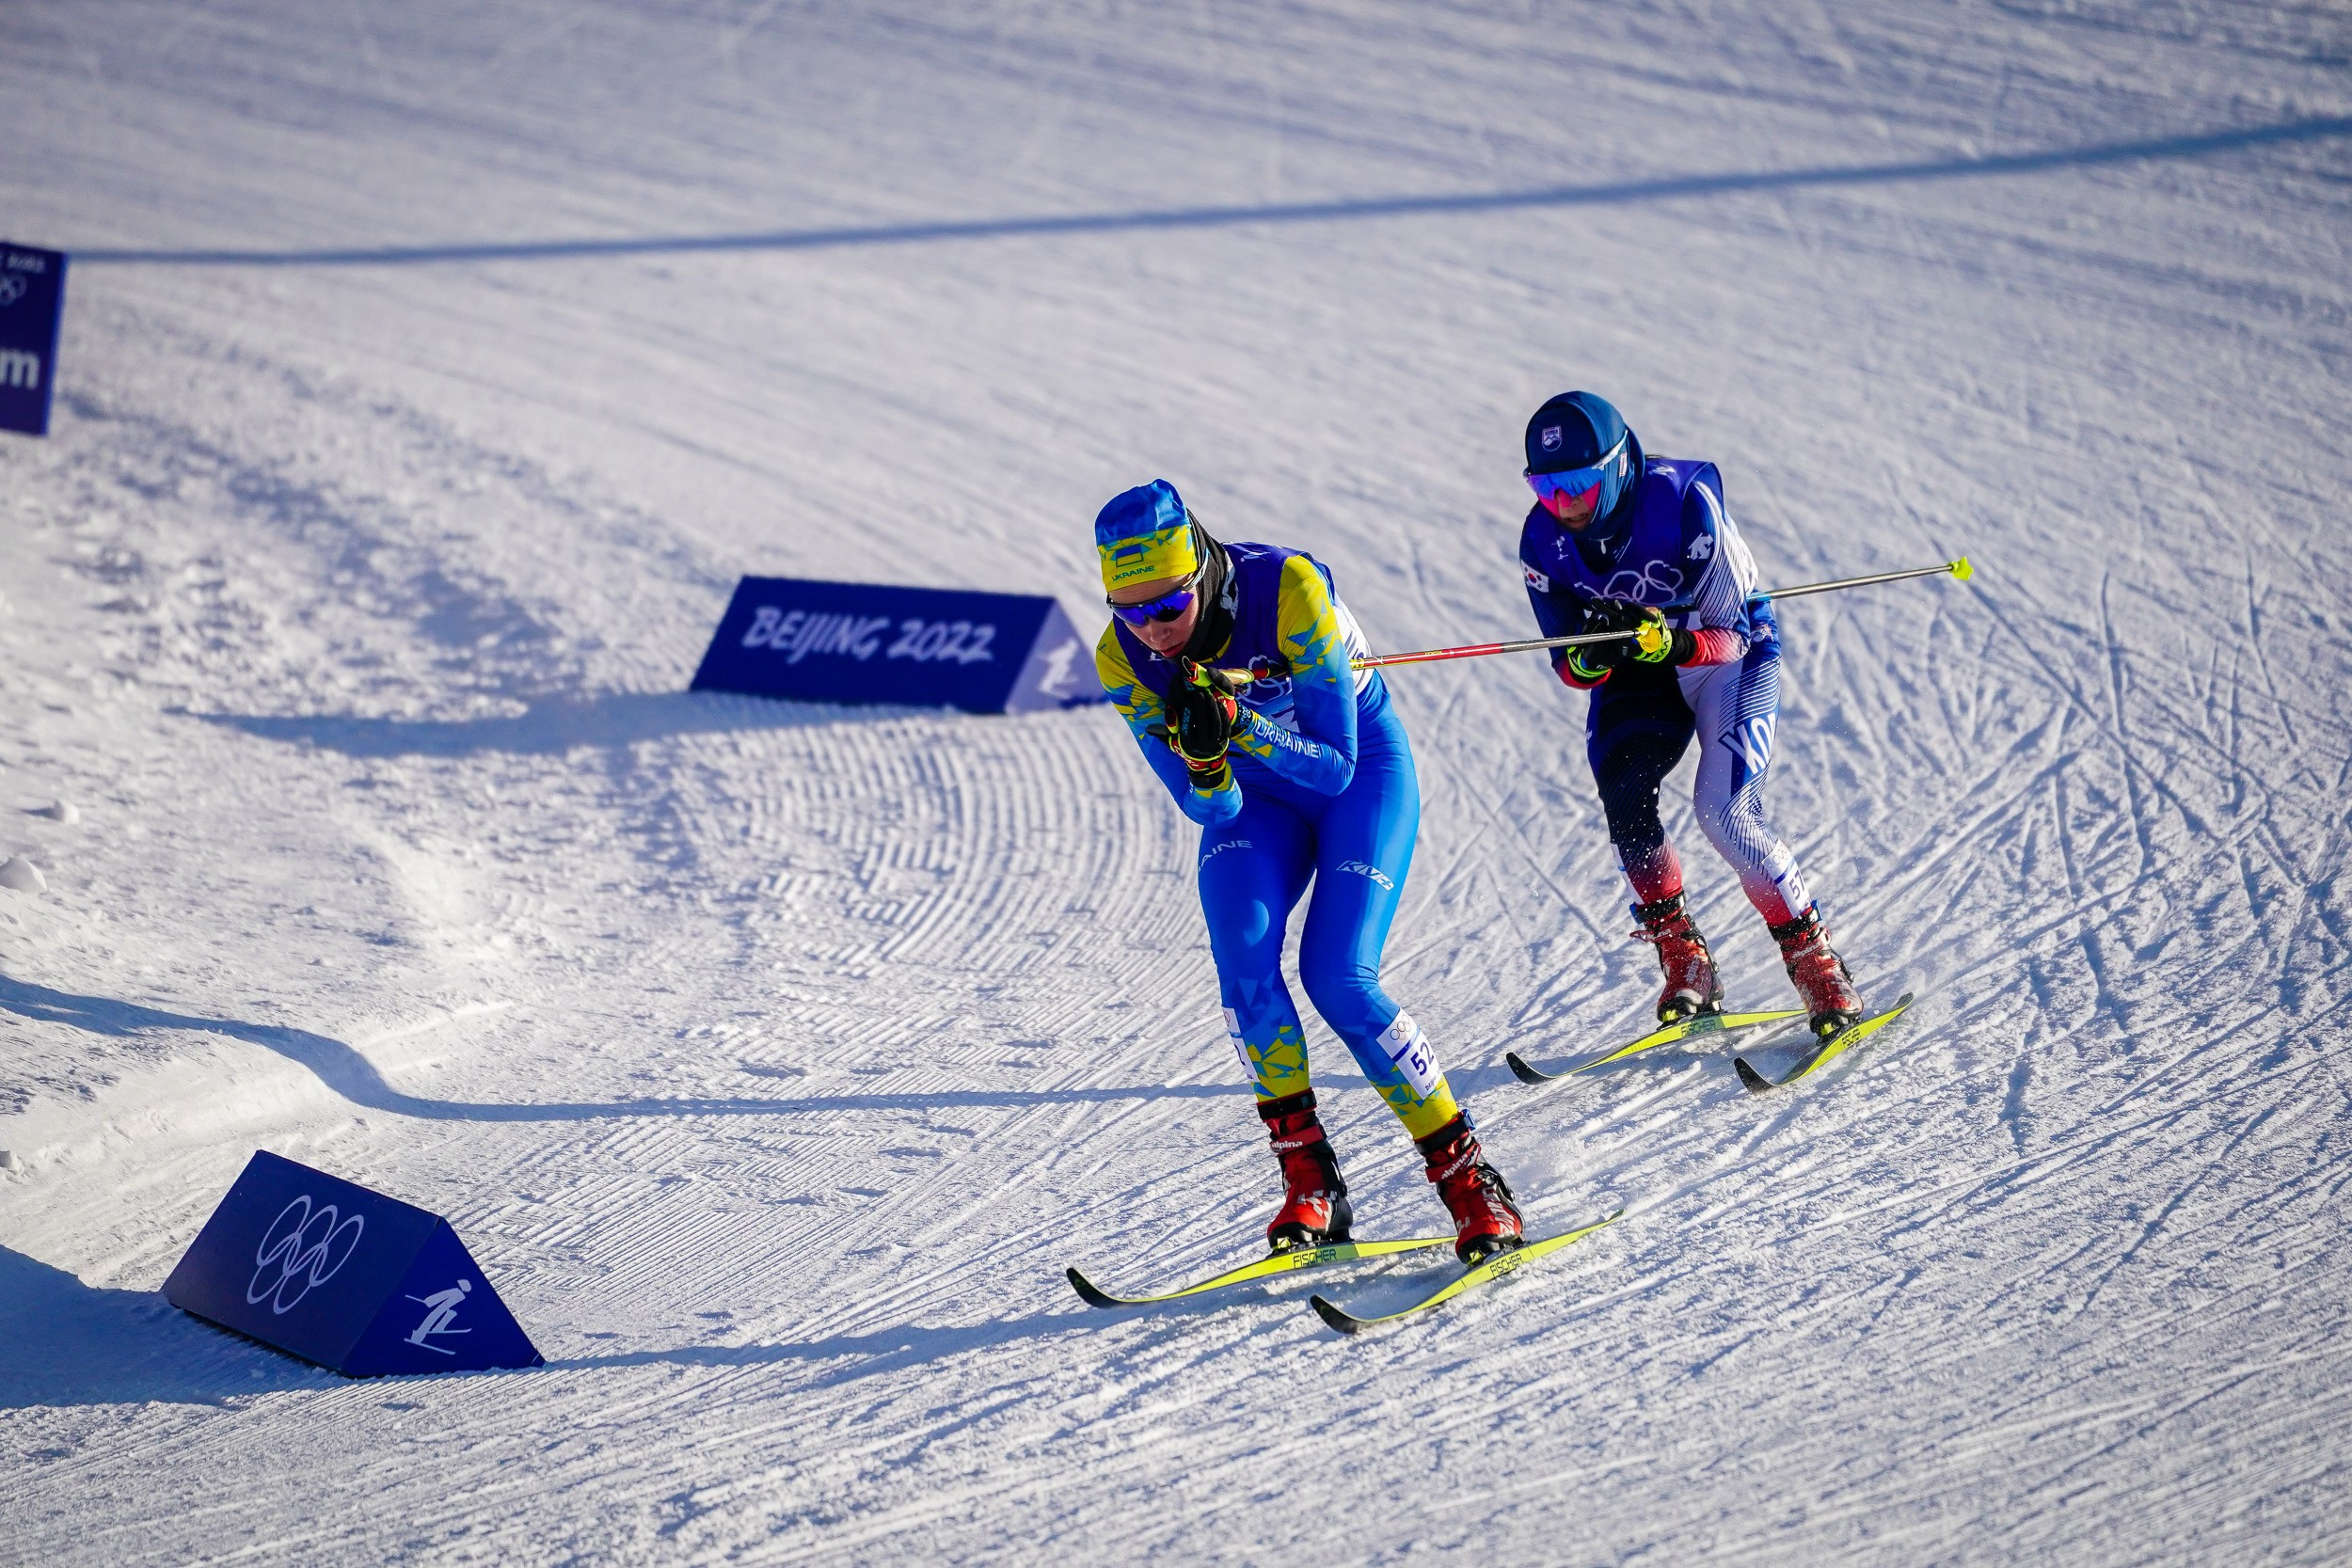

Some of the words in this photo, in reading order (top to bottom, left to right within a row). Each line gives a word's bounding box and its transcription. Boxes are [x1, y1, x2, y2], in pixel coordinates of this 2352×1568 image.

[1111, 564, 1155, 581] UKRAINE
[741, 605, 891, 665] BEIJING
[886, 618, 996, 665] 2022
[1255, 720, 1320, 759] UKRAINE
[1788, 869, 1805, 900] 57
[1410, 1041, 1435, 1077] 52
[1441, 1153, 1469, 1180] alpina
[1293, 1248, 1338, 1270] FISCHER
[1490, 1253, 1524, 1278] FISCHER
